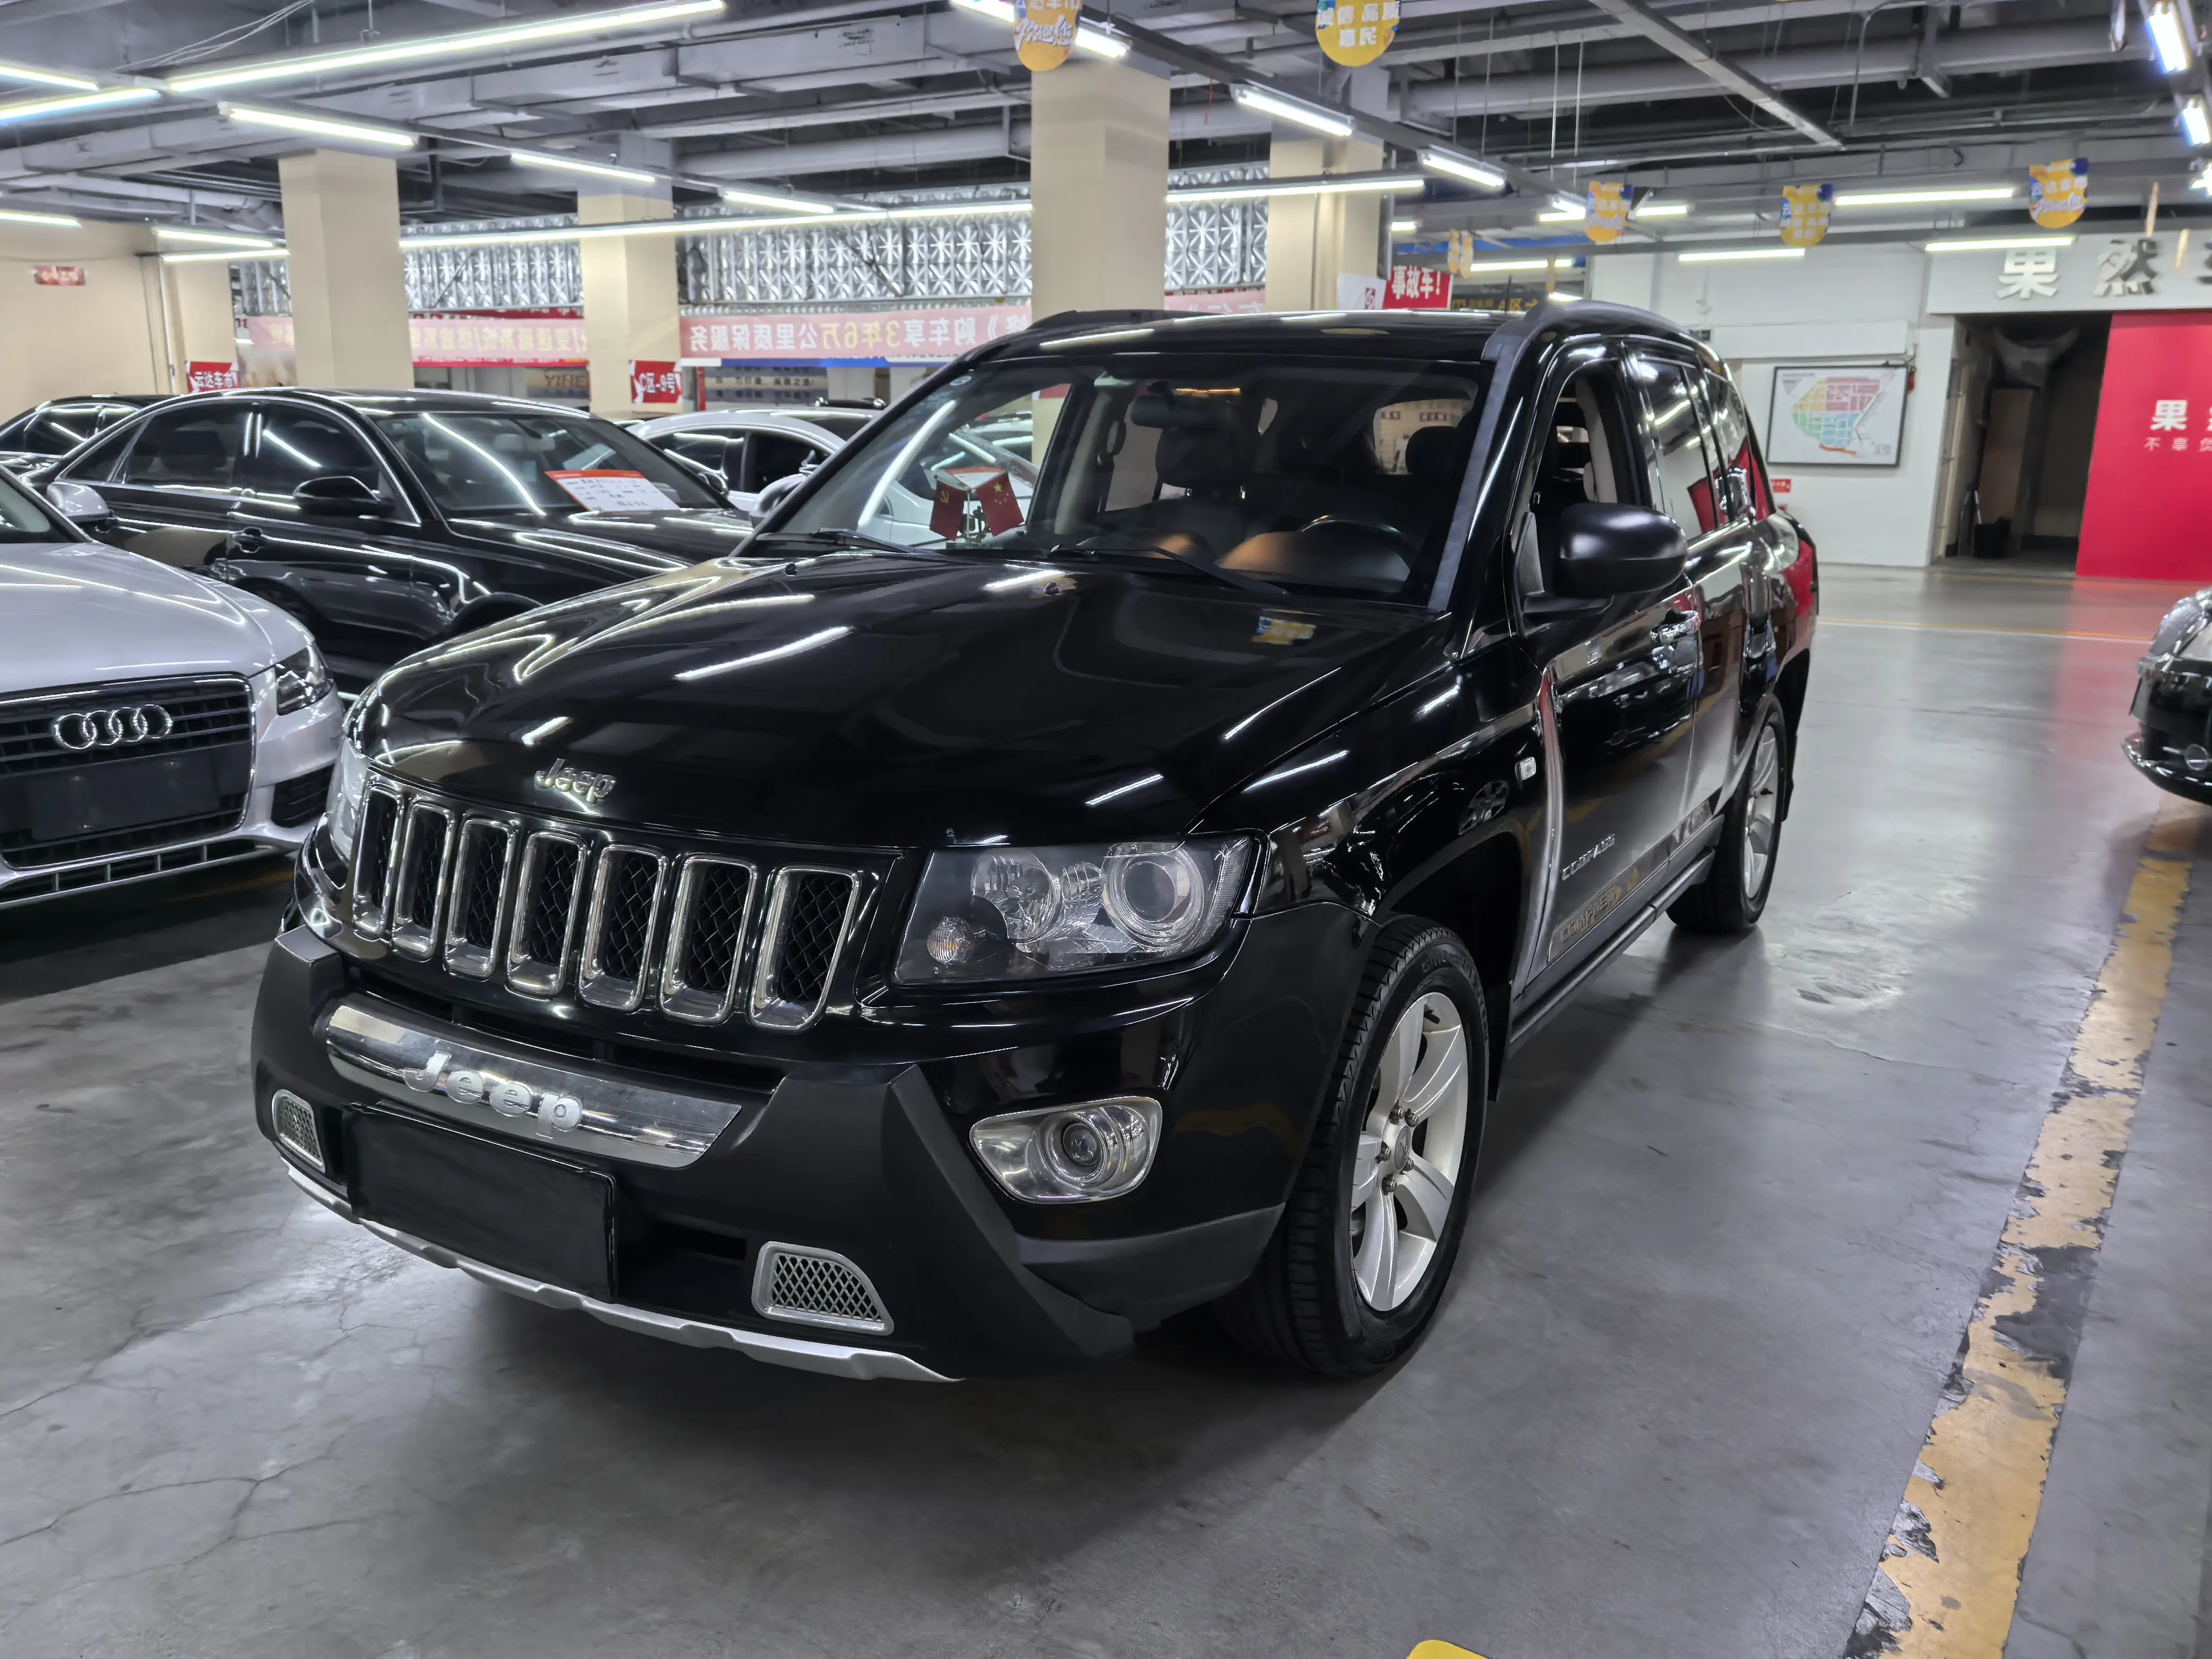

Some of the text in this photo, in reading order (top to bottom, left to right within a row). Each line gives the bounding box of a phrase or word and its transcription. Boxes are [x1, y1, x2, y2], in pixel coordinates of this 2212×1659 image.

[1997, 239, 2212, 299] 果然
[534, 758, 617, 804] Jeep
[401, 1051, 583, 1139] Jeep
